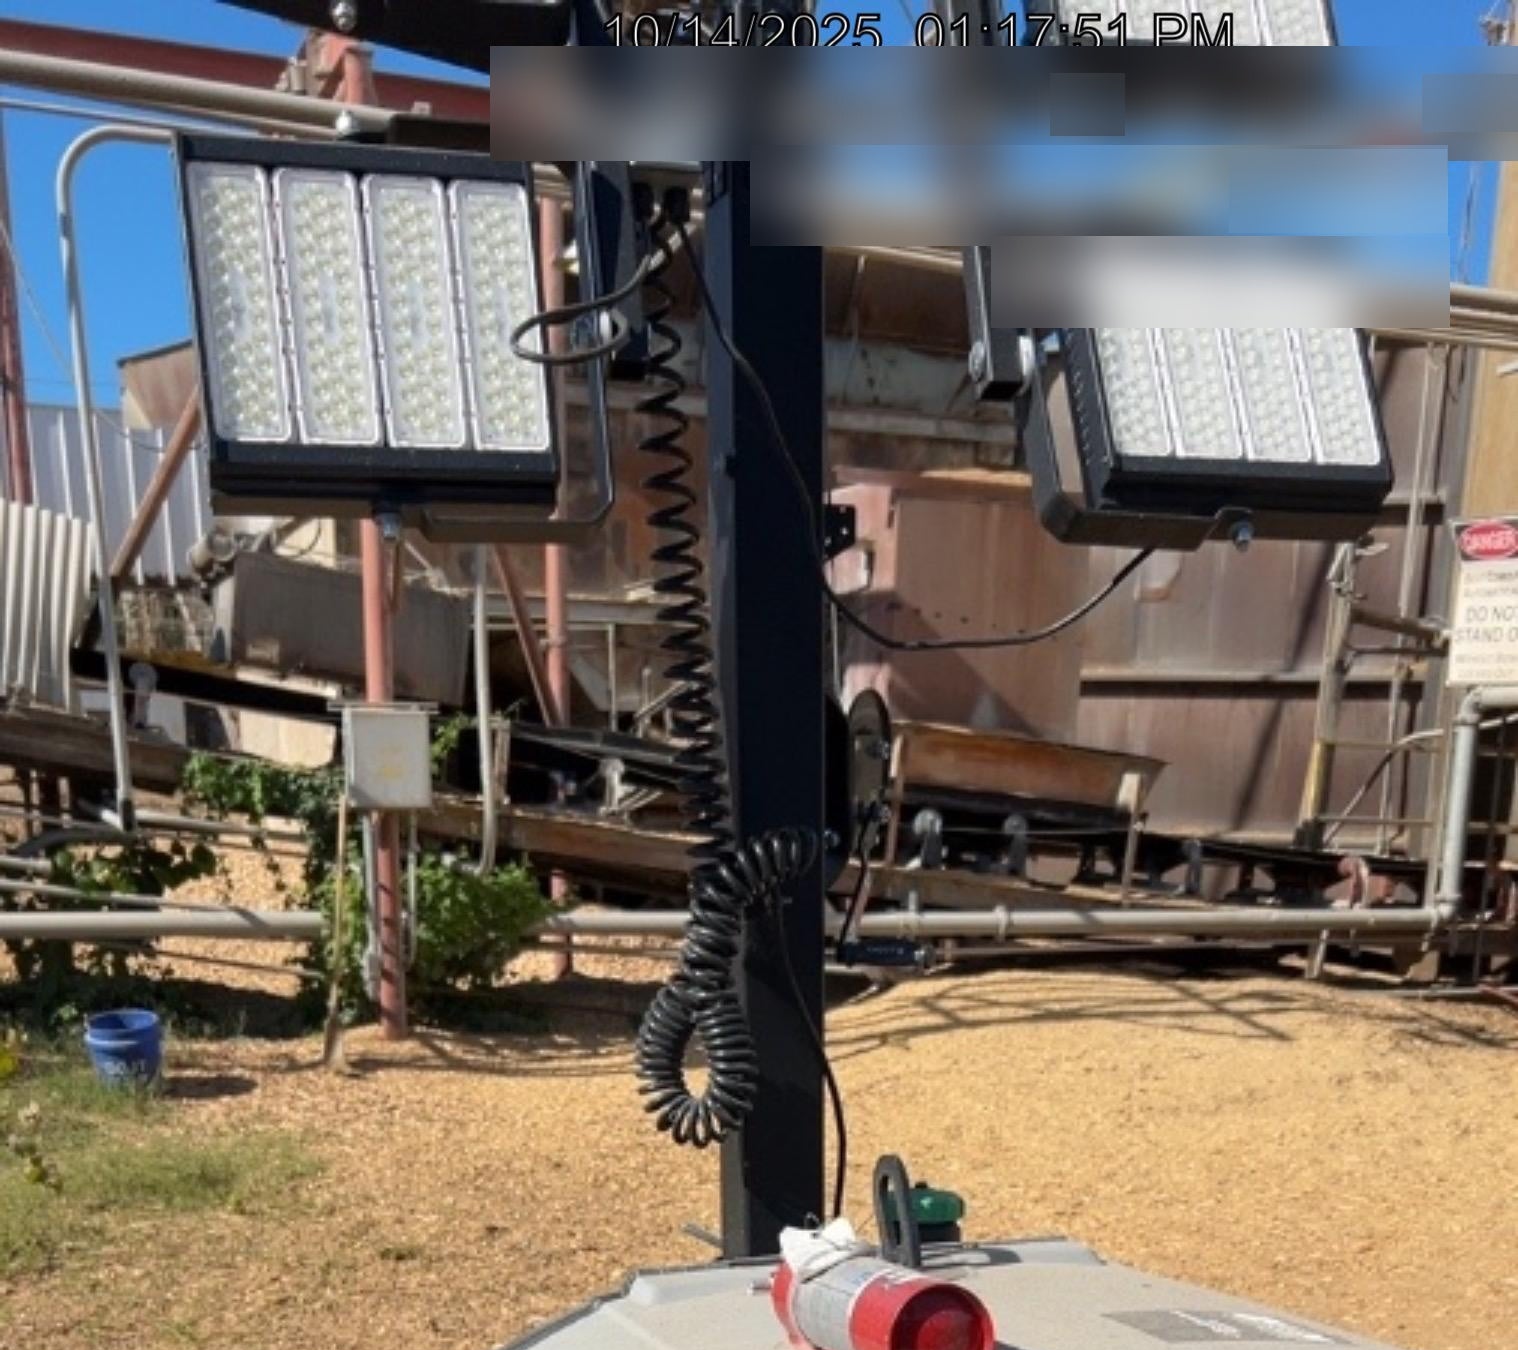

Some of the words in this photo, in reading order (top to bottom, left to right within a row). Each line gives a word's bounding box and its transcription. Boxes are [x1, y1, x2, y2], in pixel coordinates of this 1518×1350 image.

[1462, 530, 1516, 551] DANGER
[1466, 606, 1488, 623] DO
[1455, 626, 1503, 643] STAND
